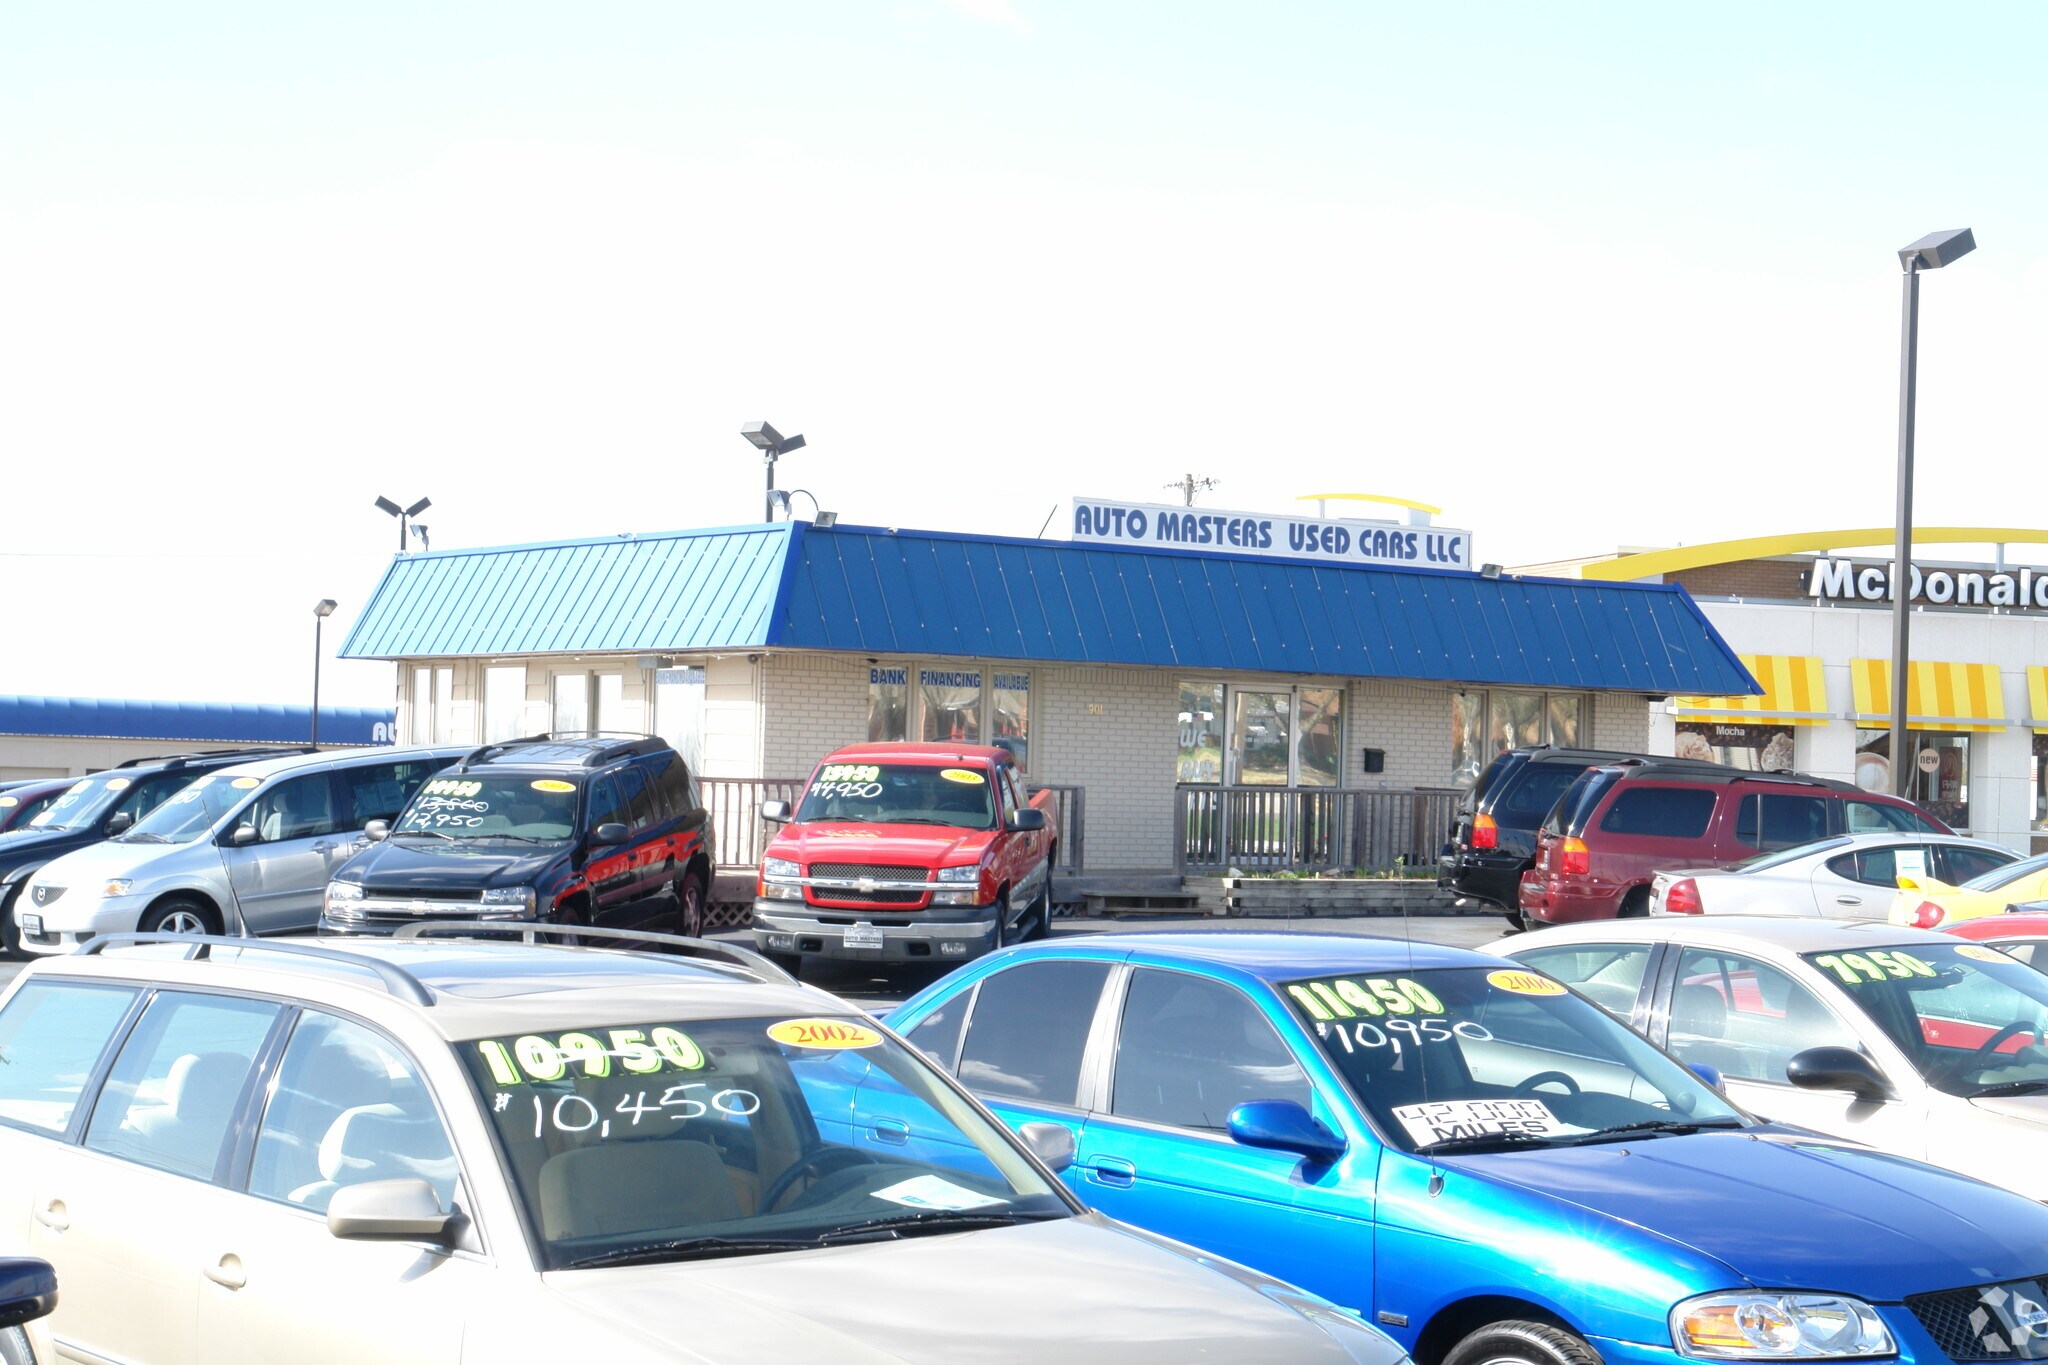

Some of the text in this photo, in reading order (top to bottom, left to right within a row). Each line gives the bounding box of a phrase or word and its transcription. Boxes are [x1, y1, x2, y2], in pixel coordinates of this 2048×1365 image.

[1075, 504, 1462, 563] AUTO MASTERS USED CARS LLC
[870, 668, 1029, 690] BANK FINANCING AVAILABLE
[1180, 728, 1208, 748] WE
[1716, 725, 1746, 737] Mocha
[1920, 755, 1939, 765] new
[1815, 951, 1937, 984] 7950
[1288, 978, 1445, 1021] 11450
[789, 1020, 865, 1043] 2002
[479, 1026, 705, 1085] 10950
[1400, 1100, 1549, 1126] 42,000
[1432, 1120, 1549, 1141] MILES
